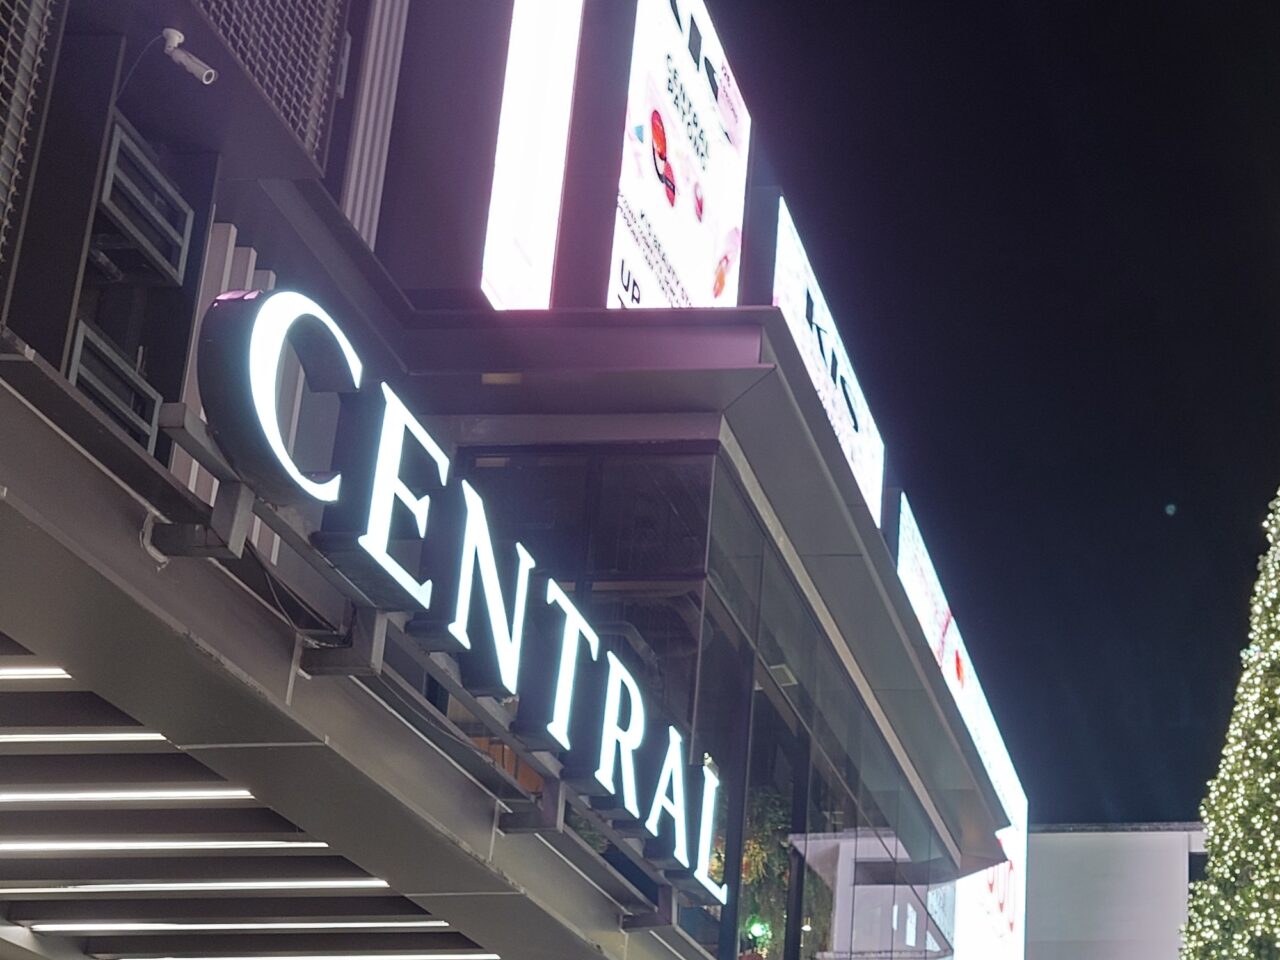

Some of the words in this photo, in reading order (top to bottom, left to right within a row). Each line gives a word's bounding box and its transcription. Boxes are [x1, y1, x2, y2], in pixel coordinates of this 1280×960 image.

[666, 53, 709, 160] CENTRAL
[667, 77, 706, 171] PATONG
[249, 290, 728, 906] CENTRAL
